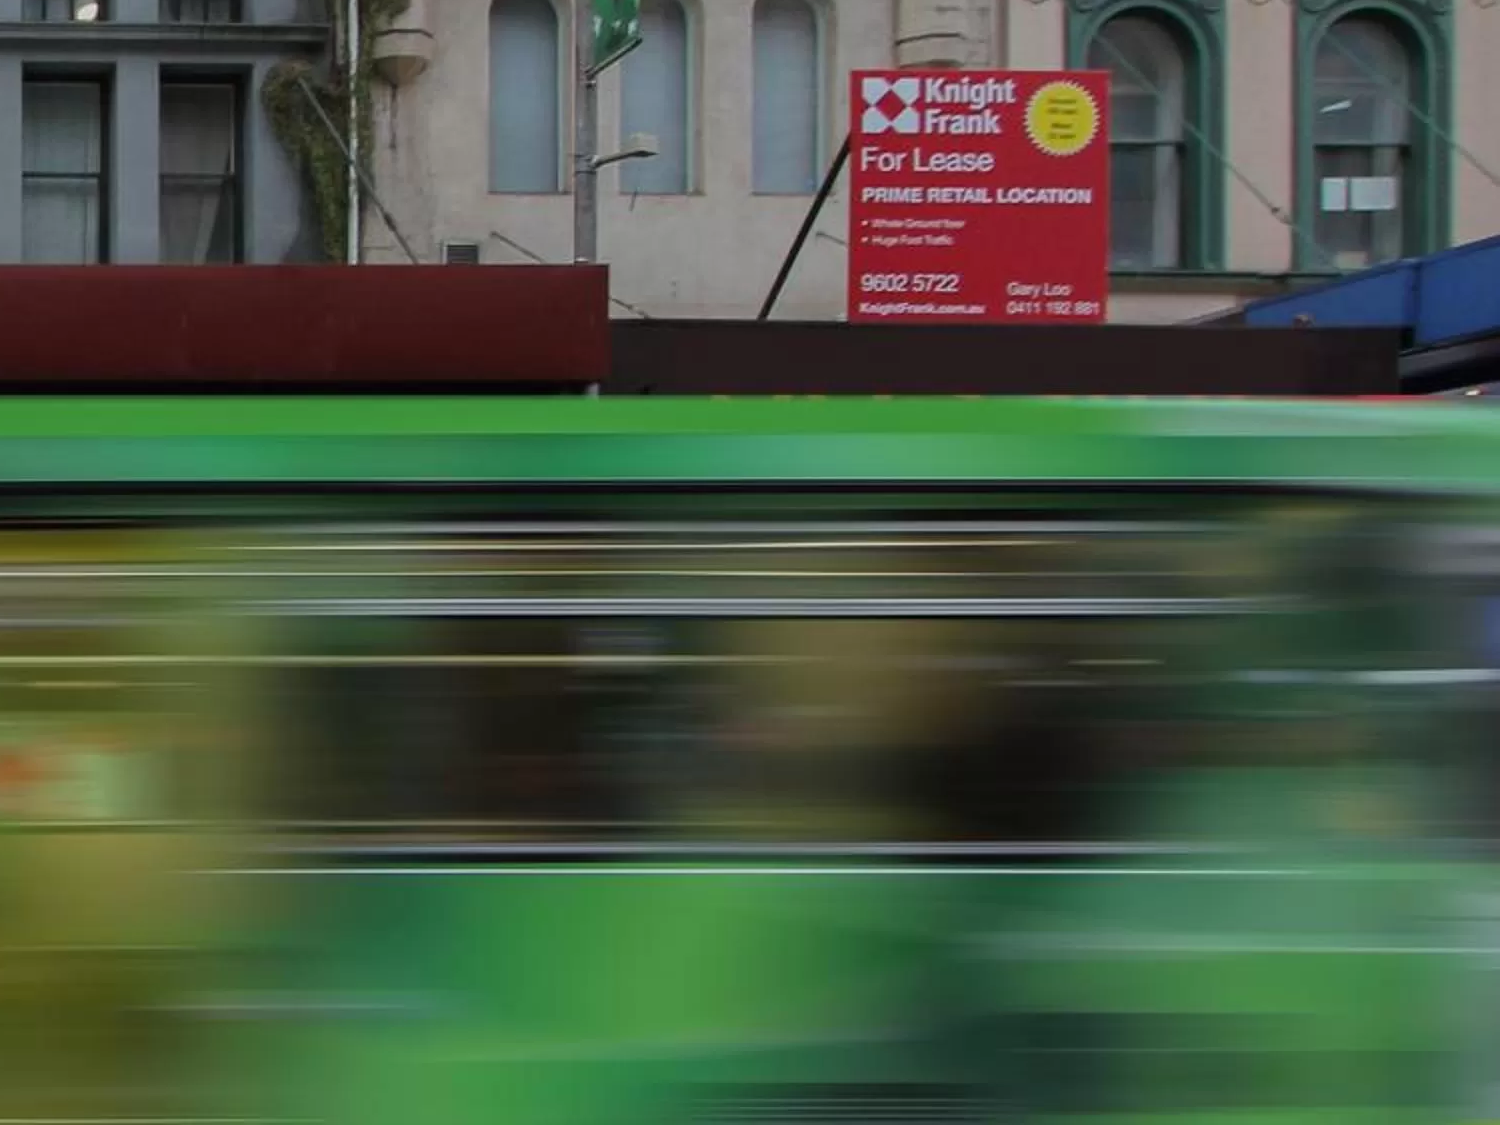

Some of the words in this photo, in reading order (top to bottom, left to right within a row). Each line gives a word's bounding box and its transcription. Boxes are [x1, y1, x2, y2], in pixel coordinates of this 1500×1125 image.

[924, 77, 1016, 109] Knight
[924, 108, 1001, 134] Frank
[861, 146, 907, 172] For
[913, 146, 995, 172] Lease
[861, 187, 924, 203] PRIME
[926, 187, 993, 203] RETAIL
[996, 187, 1092, 204] LOCATION
[860, 273, 908, 292] 9602
[911, 273, 960, 292] 5722
